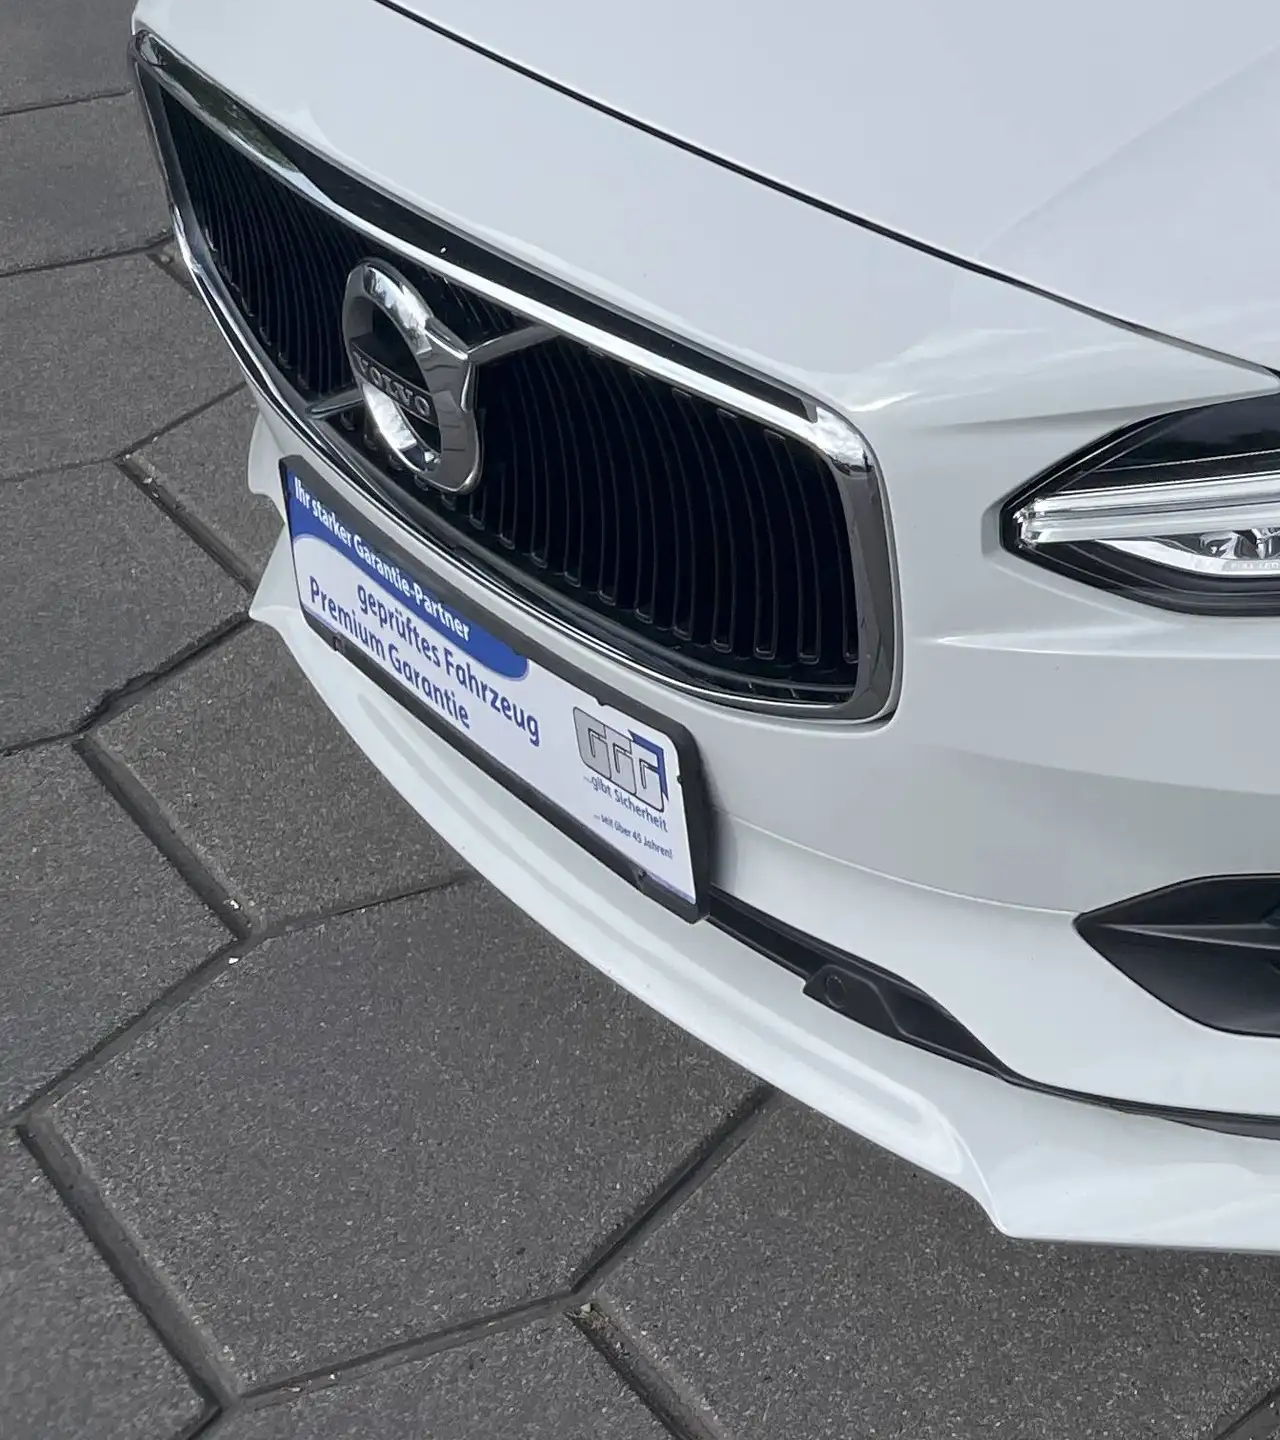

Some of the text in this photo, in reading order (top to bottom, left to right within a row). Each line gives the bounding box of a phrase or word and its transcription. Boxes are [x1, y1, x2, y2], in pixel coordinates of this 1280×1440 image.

[352, 350, 432, 418] VOLVO
[294, 477, 472, 642] Ihr starker Garantie-Partner
[309, 575, 470, 730] Premium Garantie
[357, 584, 540, 747] geprüftes Fahrzeug
[614, 788, 669, 833] Sicherheit
[614, 821, 632, 838] über
